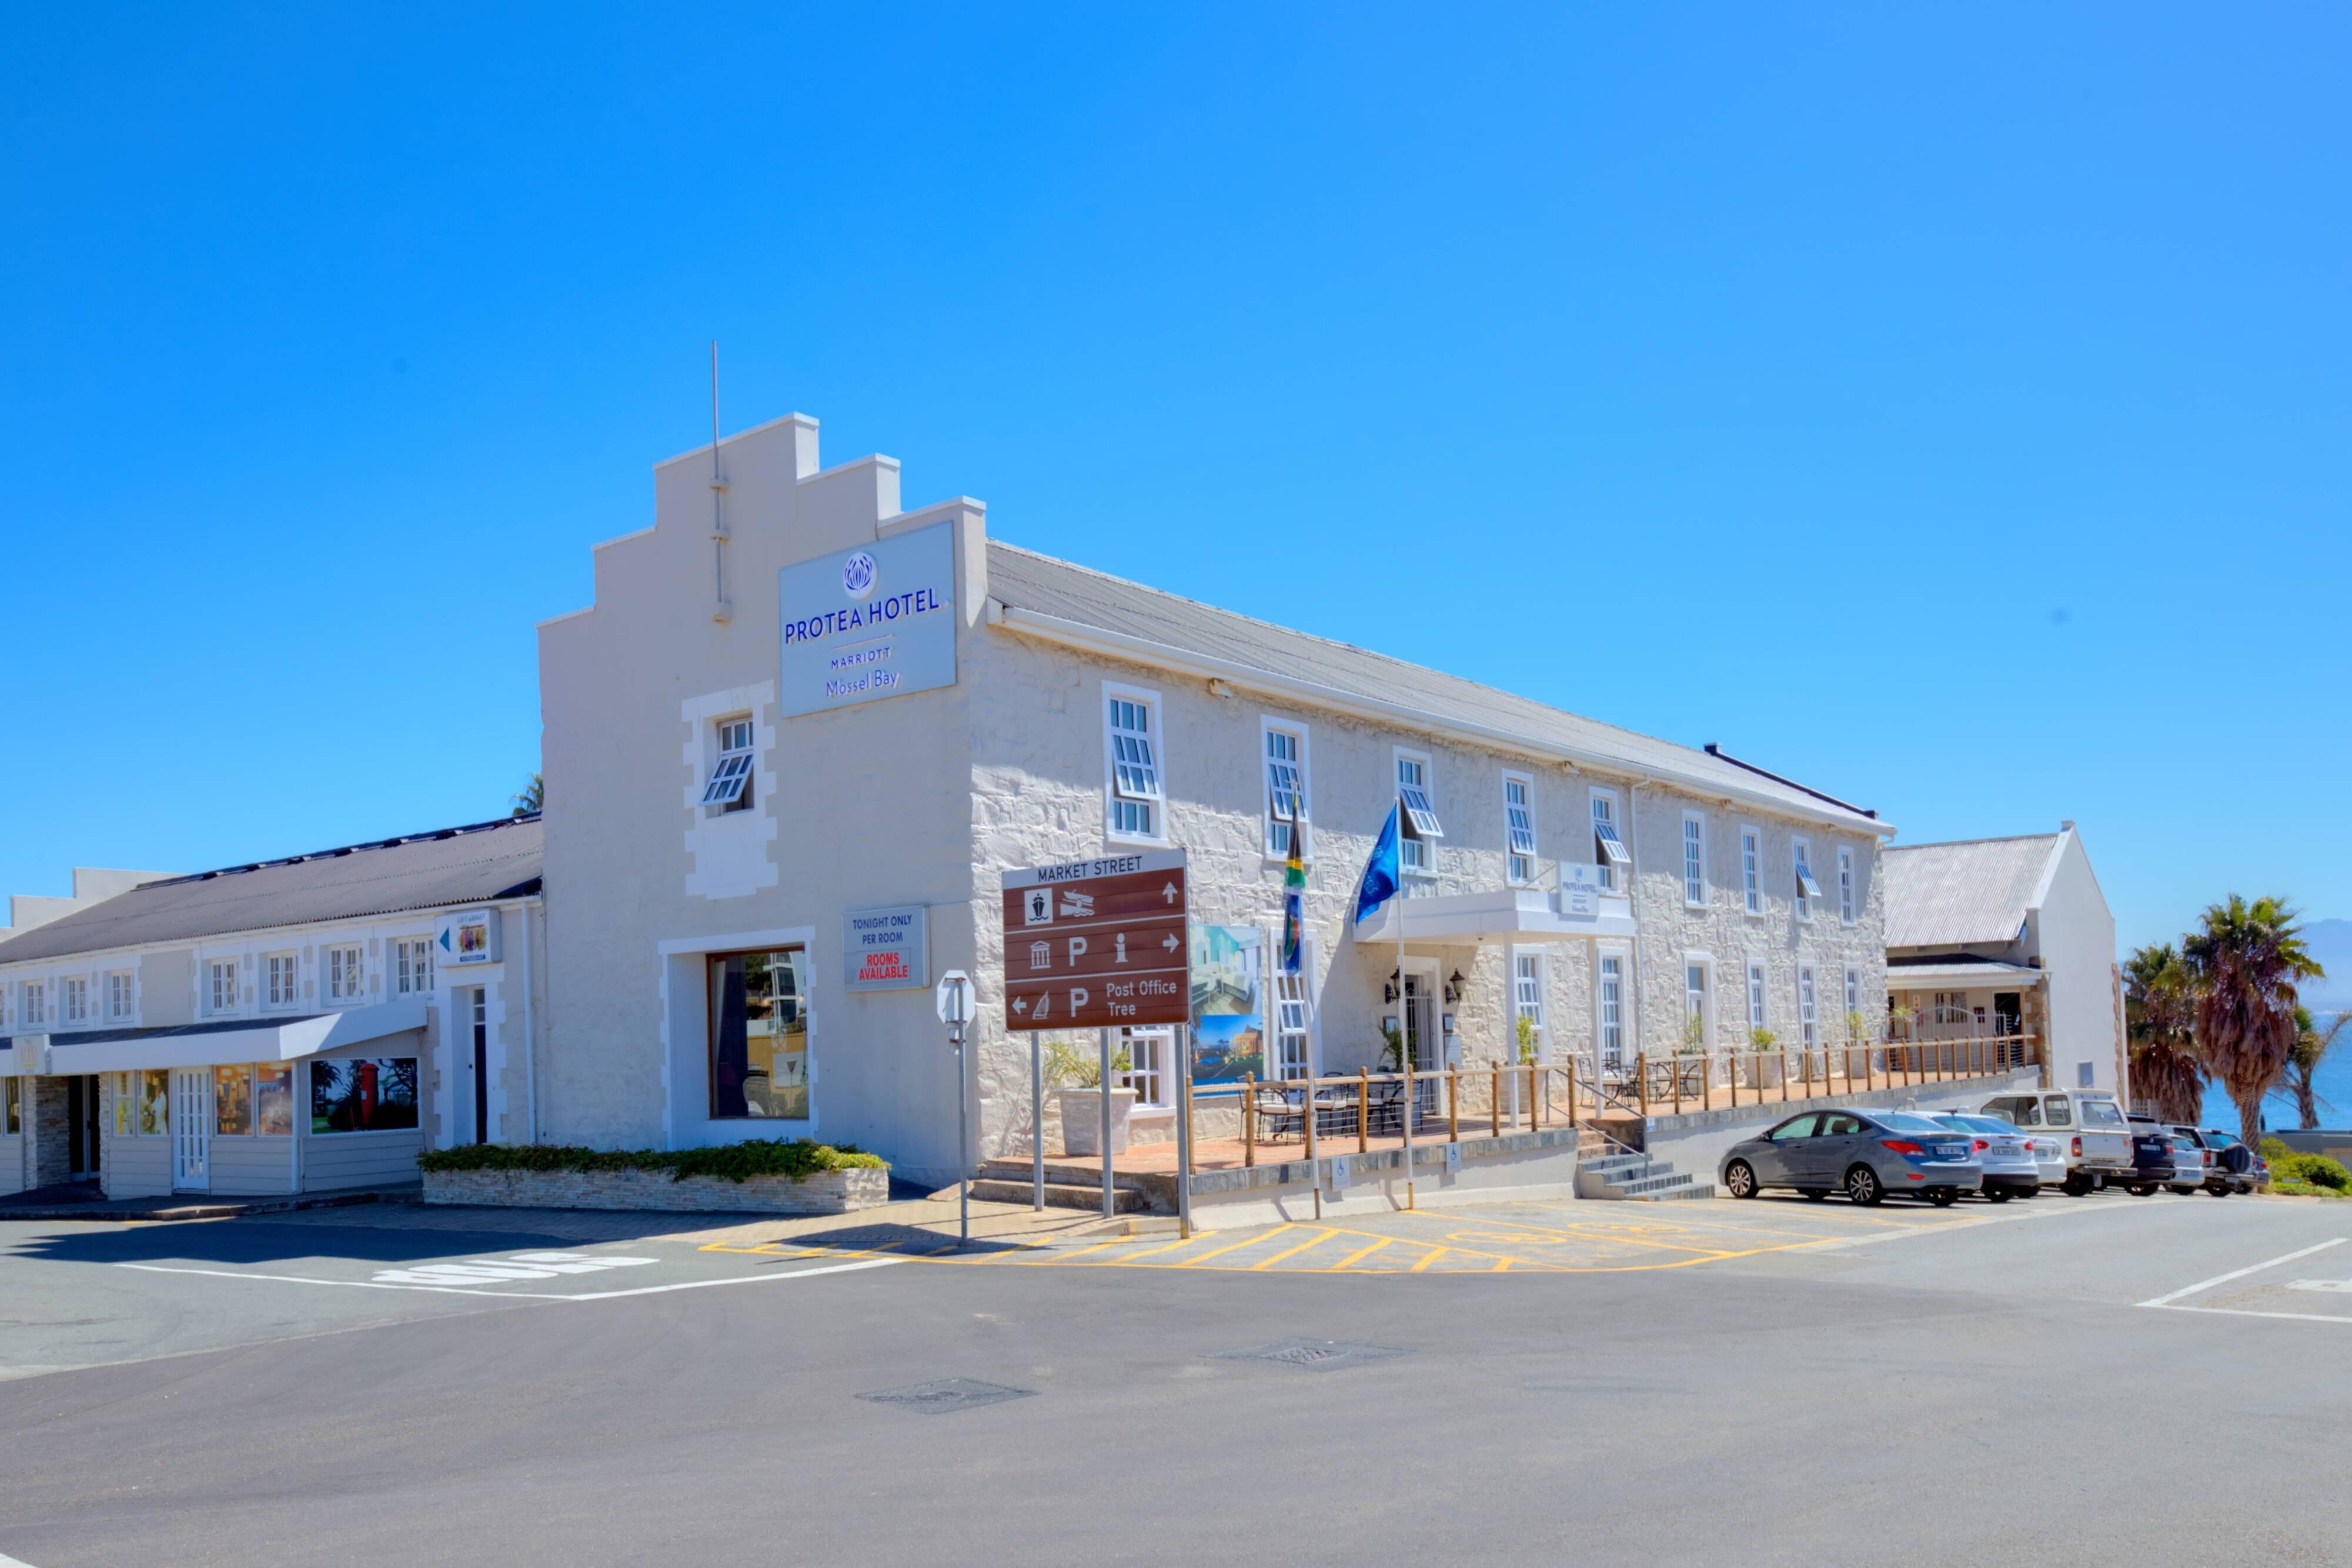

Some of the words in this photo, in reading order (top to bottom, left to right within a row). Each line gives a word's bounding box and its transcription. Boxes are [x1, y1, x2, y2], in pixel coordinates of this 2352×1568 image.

[786, 608, 863, 644] PROTEA
[870, 588, 940, 624] HOTEL
[831, 647, 891, 670] MARRIOTT
[826, 672, 870, 697] Mossel
[874, 670, 899, 688] Bay
[1038, 863, 1088, 882] MARKET
[1094, 856, 1142, 875] STREET
[1562, 881, 1580, 892] PROTEA
[853, 917, 888, 930] TONIGHT
[891, 915, 912, 927] ONLY
[863, 934, 876, 945] PER
[878, 931, 903, 944] ROOM
[867, 952, 899, 967] ROOMS
[1068, 937, 1087, 967] P
[858, 965, 908, 980] AVAILABLE
[1107, 981, 1134, 998] Post
[1140, 979, 1177, 995] Office
[1070, 988, 1089, 1018] P
[1107, 1002, 1136, 1017] Tree
